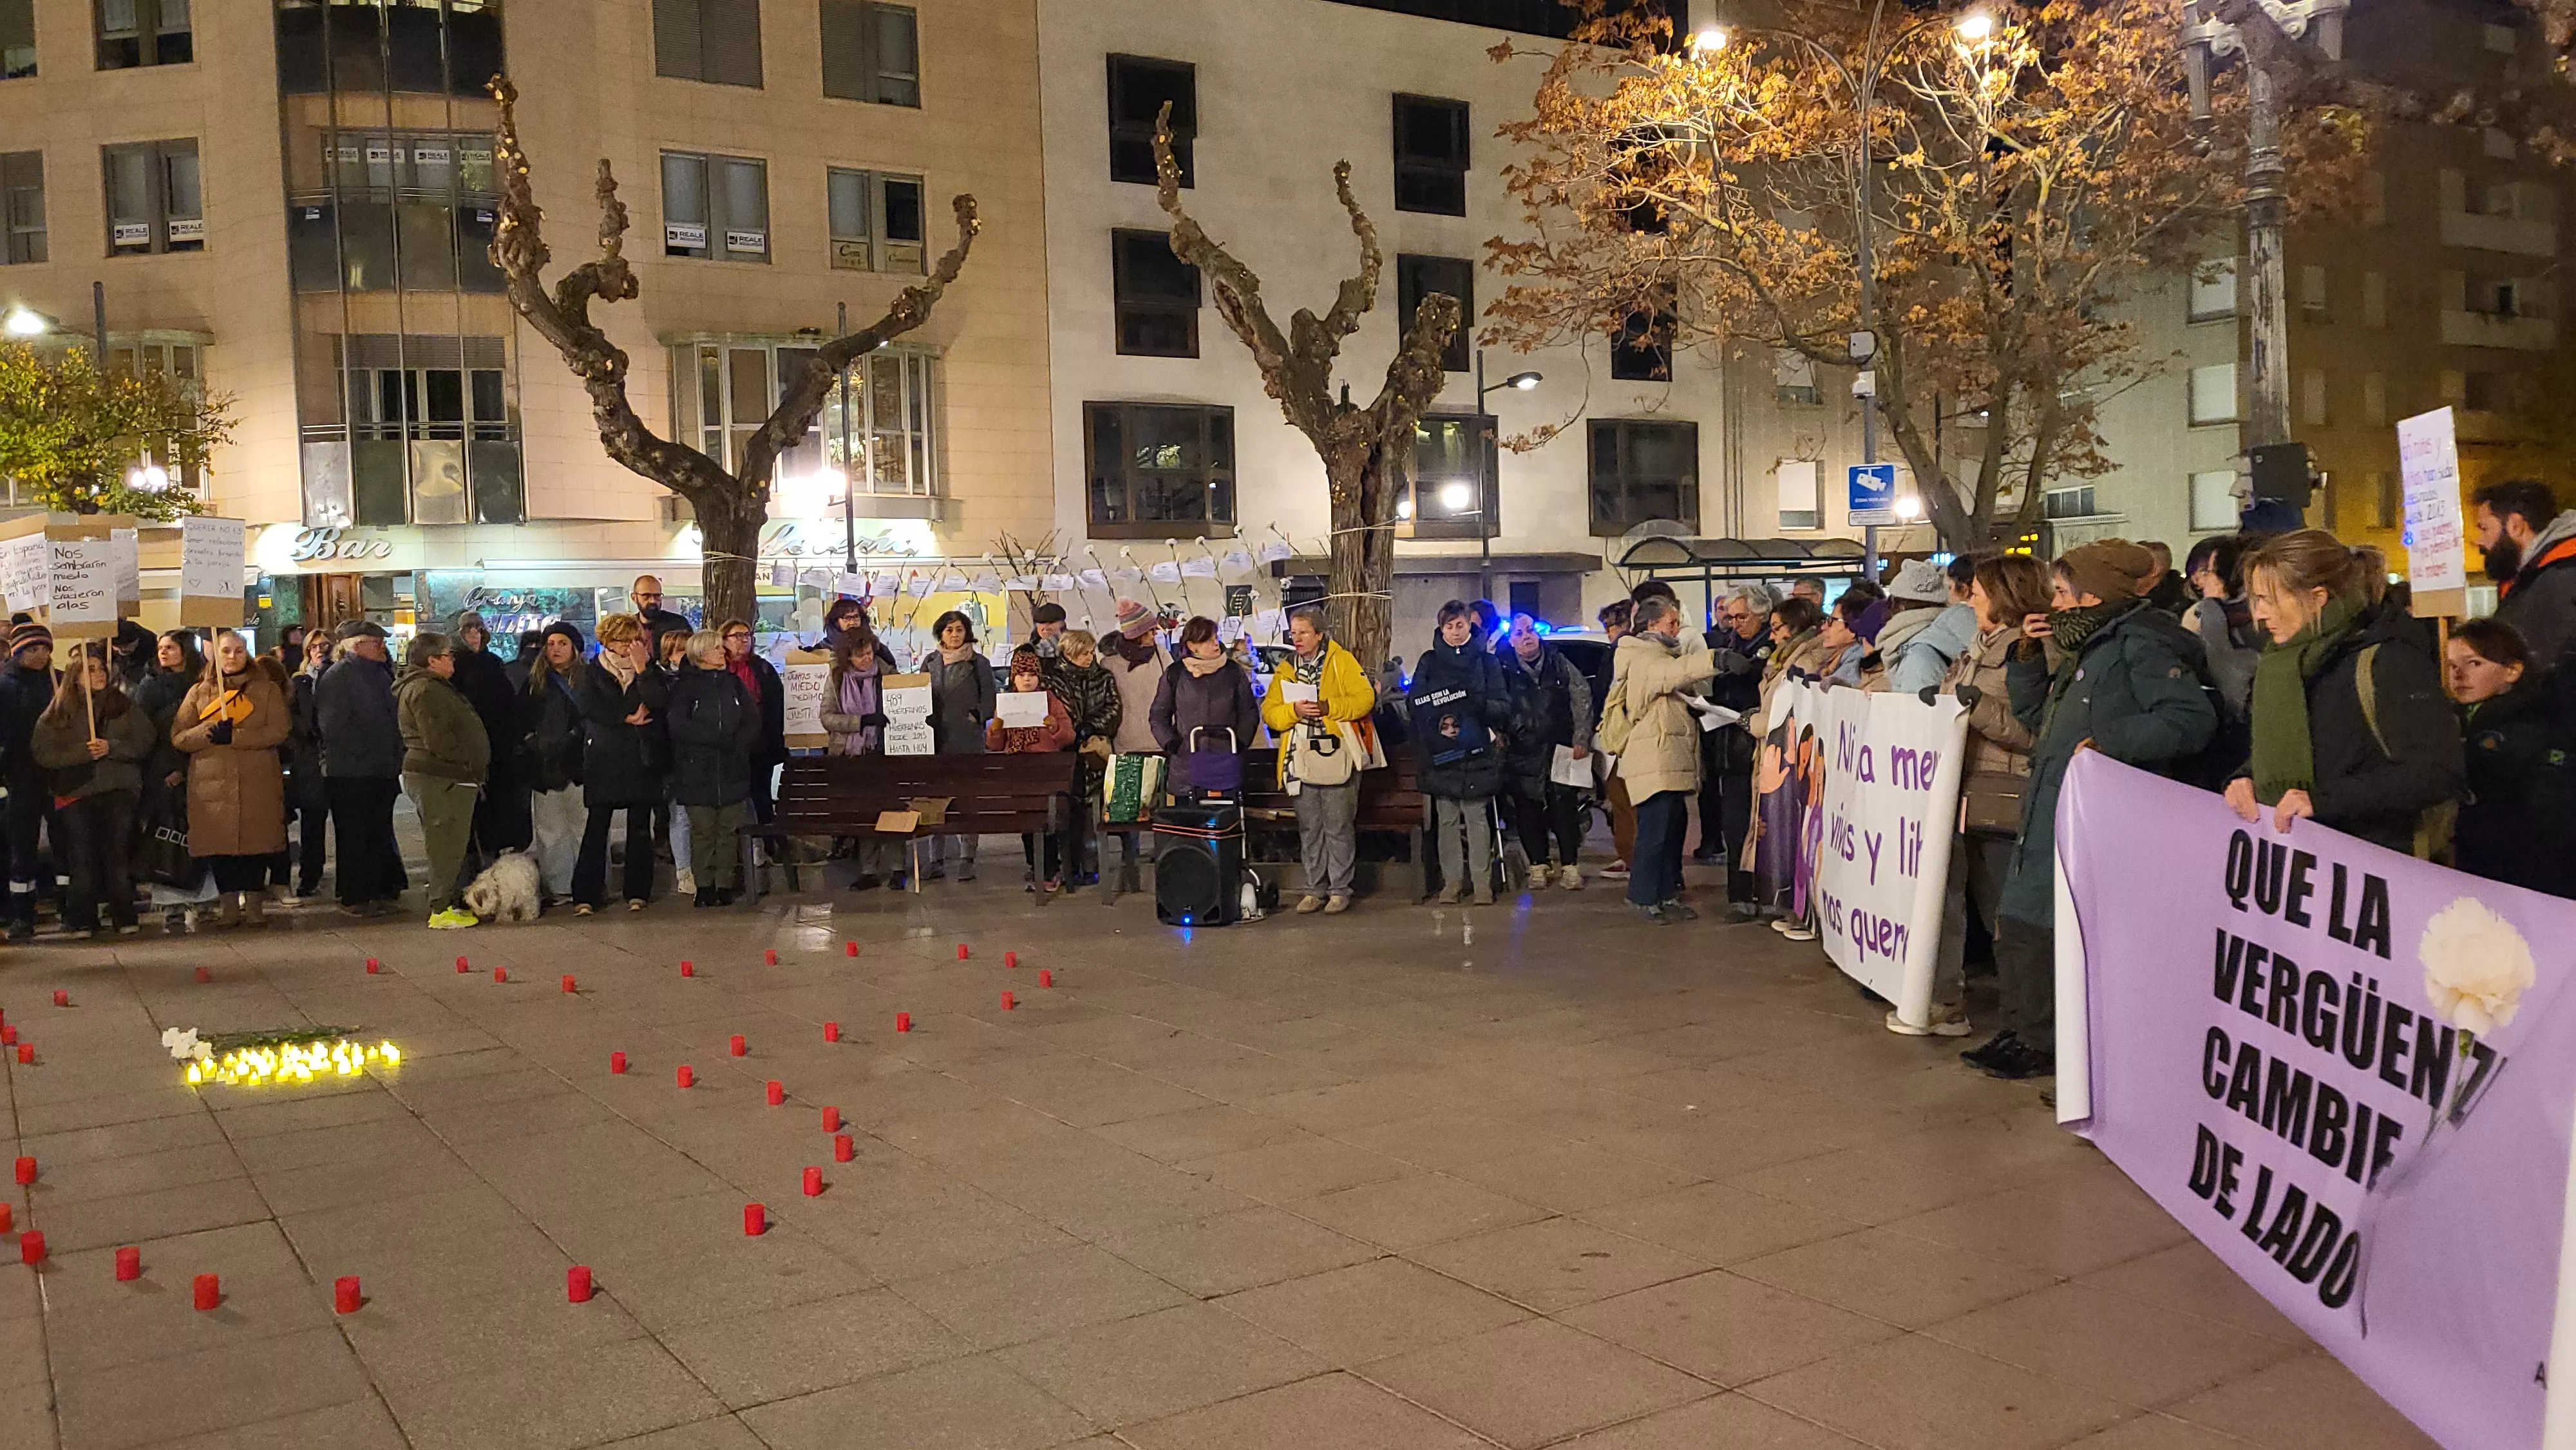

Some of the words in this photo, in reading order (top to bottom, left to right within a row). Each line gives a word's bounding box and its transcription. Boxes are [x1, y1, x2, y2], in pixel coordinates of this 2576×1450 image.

[185, 522, 216, 532] QUERER
[220, 525, 231, 534] NO
[233, 527, 243, 535] ES
[14, 543, 44, 558] España
[290, 526, 393, 561] Bar
[55, 546, 83, 560] Nos
[49, 559, 106, 570] sembraron
[53, 570, 89, 581] miedo
[55, 584, 75, 594] Nos
[56, 600, 89, 610] alas
[463, 585, 539, 613] Granja
[790, 692, 824, 702] PEDIMO
[886, 693, 902, 706] 489
[1414, 695, 1431, 706] ELLAS
[1431, 690, 1443, 700] SON
[1432, 690, 1467, 706] REVOLUCIÓN
[889, 744, 911, 753] HASTA
[913, 743, 927, 753] HOY
[1837, 719, 1856, 774] Ni
[1864, 829, 1882, 886] y
[2225, 829, 2318, 928] QUE
[2327, 862, 2392, 961] LA
[1822, 888, 1842, 936] nos
[2213, 927, 2508, 1131] VERGÜENZ
[2188, 1122, 2245, 1221] DE
[2240, 1163, 2362, 1310] LADO
